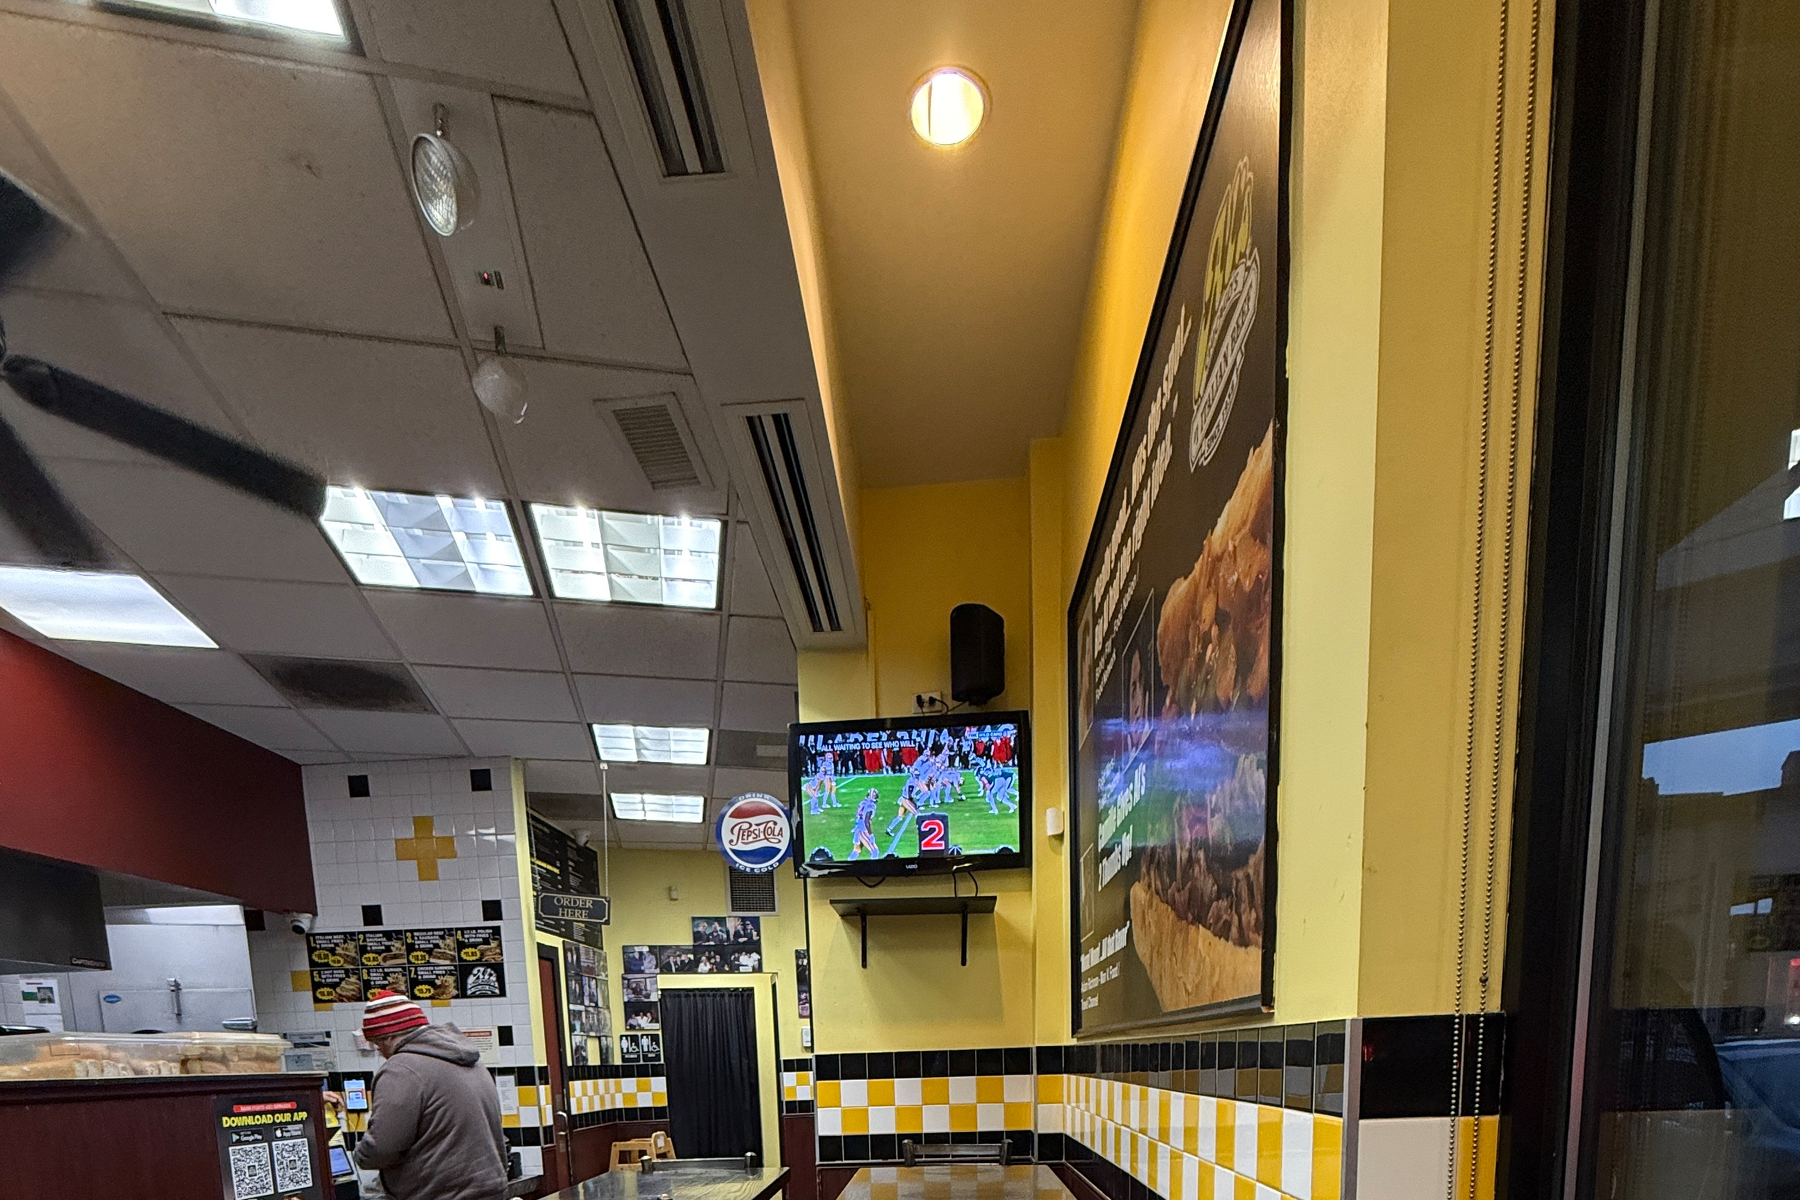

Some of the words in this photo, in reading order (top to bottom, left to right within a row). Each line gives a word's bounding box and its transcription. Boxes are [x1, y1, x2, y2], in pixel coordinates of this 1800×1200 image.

[1201, 340, 1230, 433] ITALIAN
[1231, 289, 1251, 355] BEEF
[1131, 435, 1146, 503] Hits
[1147, 387, 1161, 455] the
[1120, 537, 1131, 588] the
[1131, 478, 1150, 558] right
[834, 741, 860, 751] WAITING
[861, 741, 870, 749] TO
[871, 740, 883, 748] SEE
[884, 739, 899, 748] WHO
[900, 738, 916, 747] WILL
[1116, 781, 1132, 826] Gives
[921, 820, 945, 850] 2
[735, 862, 751, 872] ICE
[754, 861, 779, 873] COLD
[554, 896, 593, 908] ORDER
[558, 908, 589, 919] HERE
[222, 1113, 273, 1127] DOWNLOAD
[274, 1112, 291, 1123] OUR
[293, 1111, 308, 1121] APP
